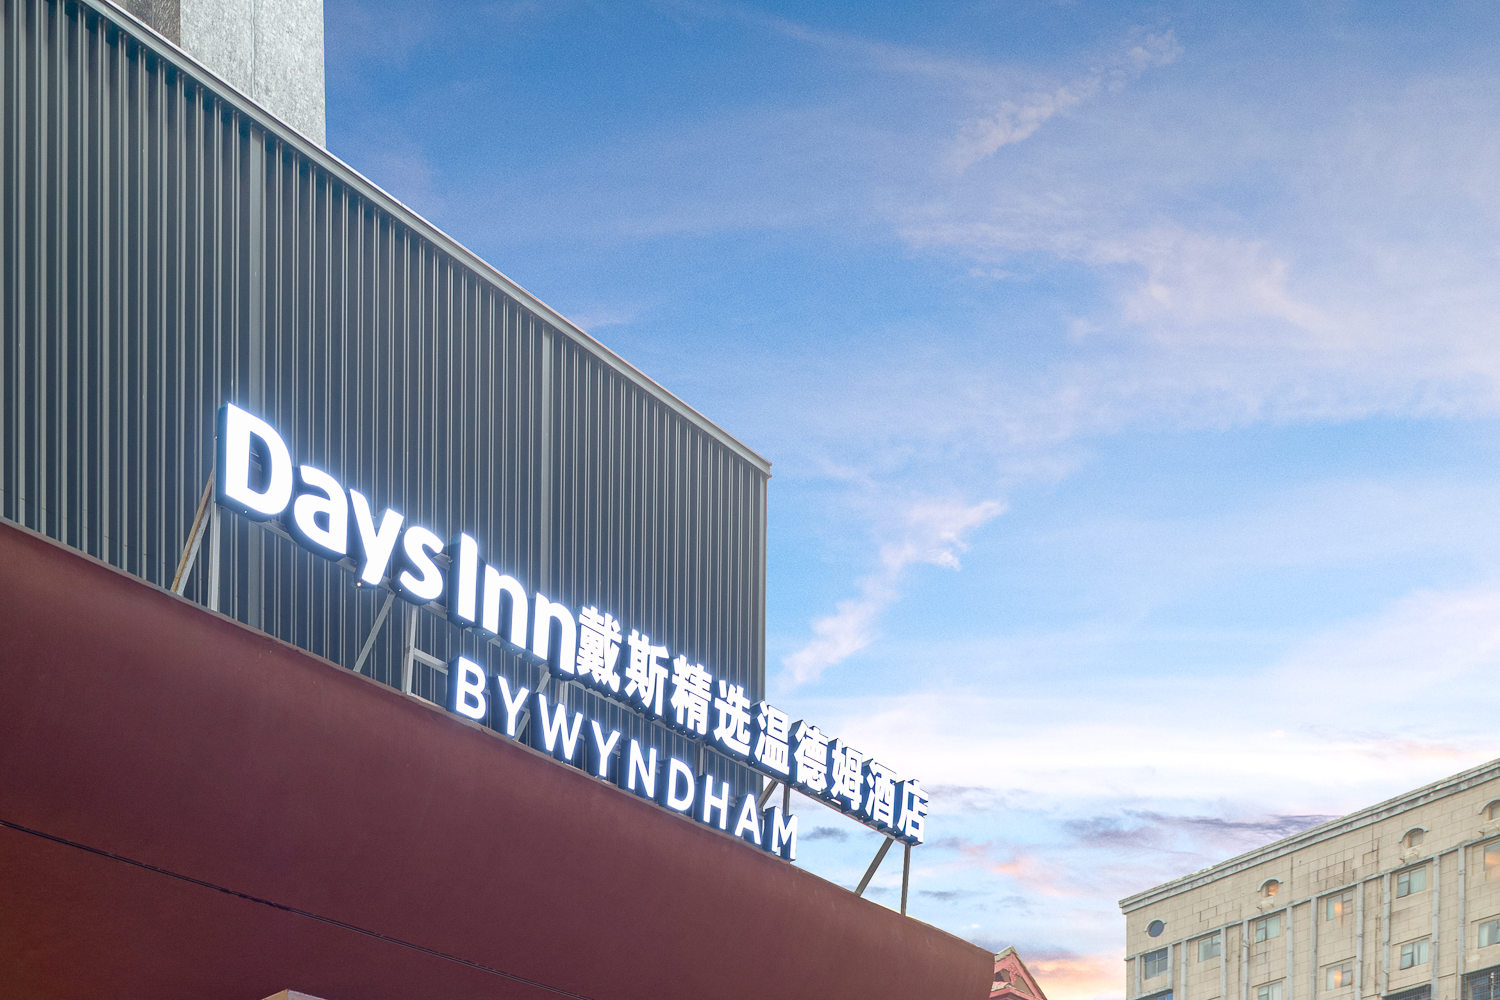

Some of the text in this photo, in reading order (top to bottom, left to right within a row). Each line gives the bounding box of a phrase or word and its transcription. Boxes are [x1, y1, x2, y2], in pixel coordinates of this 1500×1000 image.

[224, 401, 930, 845] Days Inn 戴斯精选温德姆酒店
